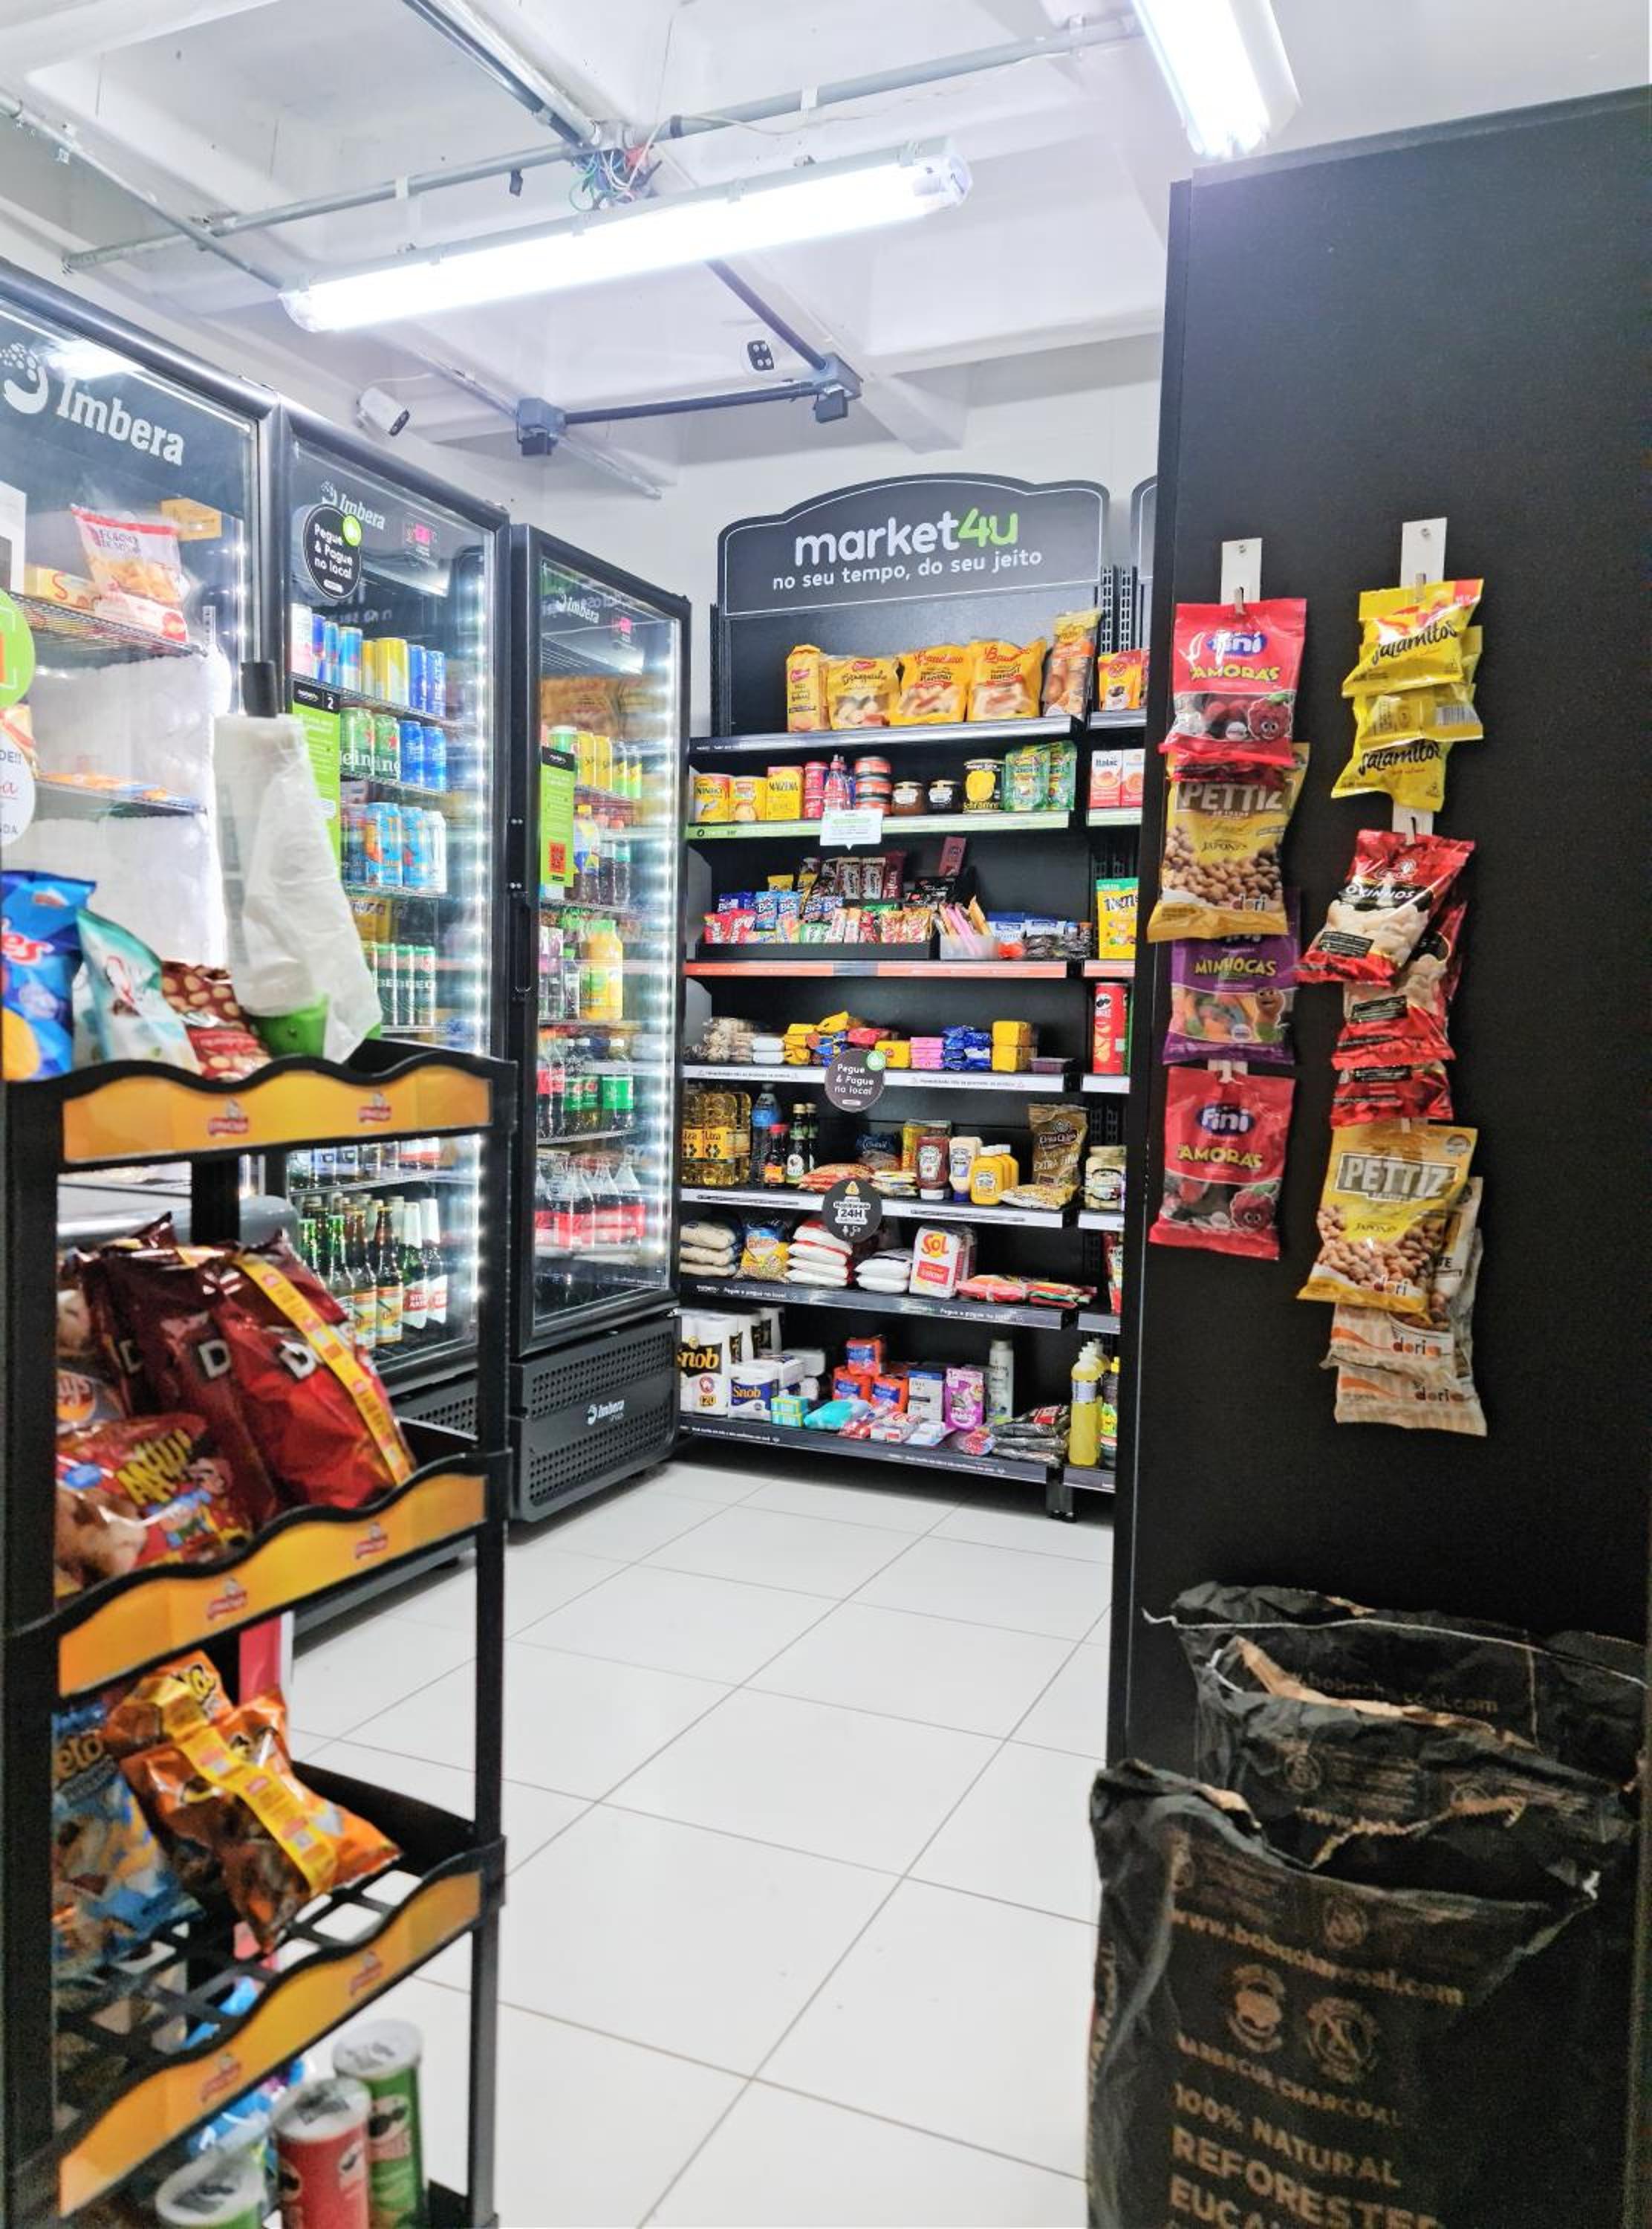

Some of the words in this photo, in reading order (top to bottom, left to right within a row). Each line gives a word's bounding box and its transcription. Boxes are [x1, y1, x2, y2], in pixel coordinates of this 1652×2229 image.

[56, 374, 185, 466] Imbera
[339, 493, 386, 530] Imbera
[314, 522, 344, 546] Pegue
[325, 544, 353, 566] Pague
[314, 557, 328, 570] no
[329, 562, 353, 580] local
[773, 573, 796, 591] no
[802, 569, 834, 587] seu
[842, 563, 911, 585] tempo,
[918, 557, 943, 576] do
[951, 555, 986, 573] seu
[993, 548, 1042, 571] jeito
[1189, 663, 1280, 681] AMORAS
[1194, 959, 1276, 977] MINHOCAS
[837, 1063, 865, 1075] Pegue
[834, 1086, 846, 1094] no
[849, 1086, 873, 1096] local
[845, 1077, 874, 1087] Pague
[1177, 1143, 1263, 1167] AMORAS
[1343, 1157, 1444, 1197] PETTIZ
[840, 1209, 862, 1218] 24H
[732, 1385, 761, 1398] Snob
[1252, 2116, 1402, 2188] NATURAL
